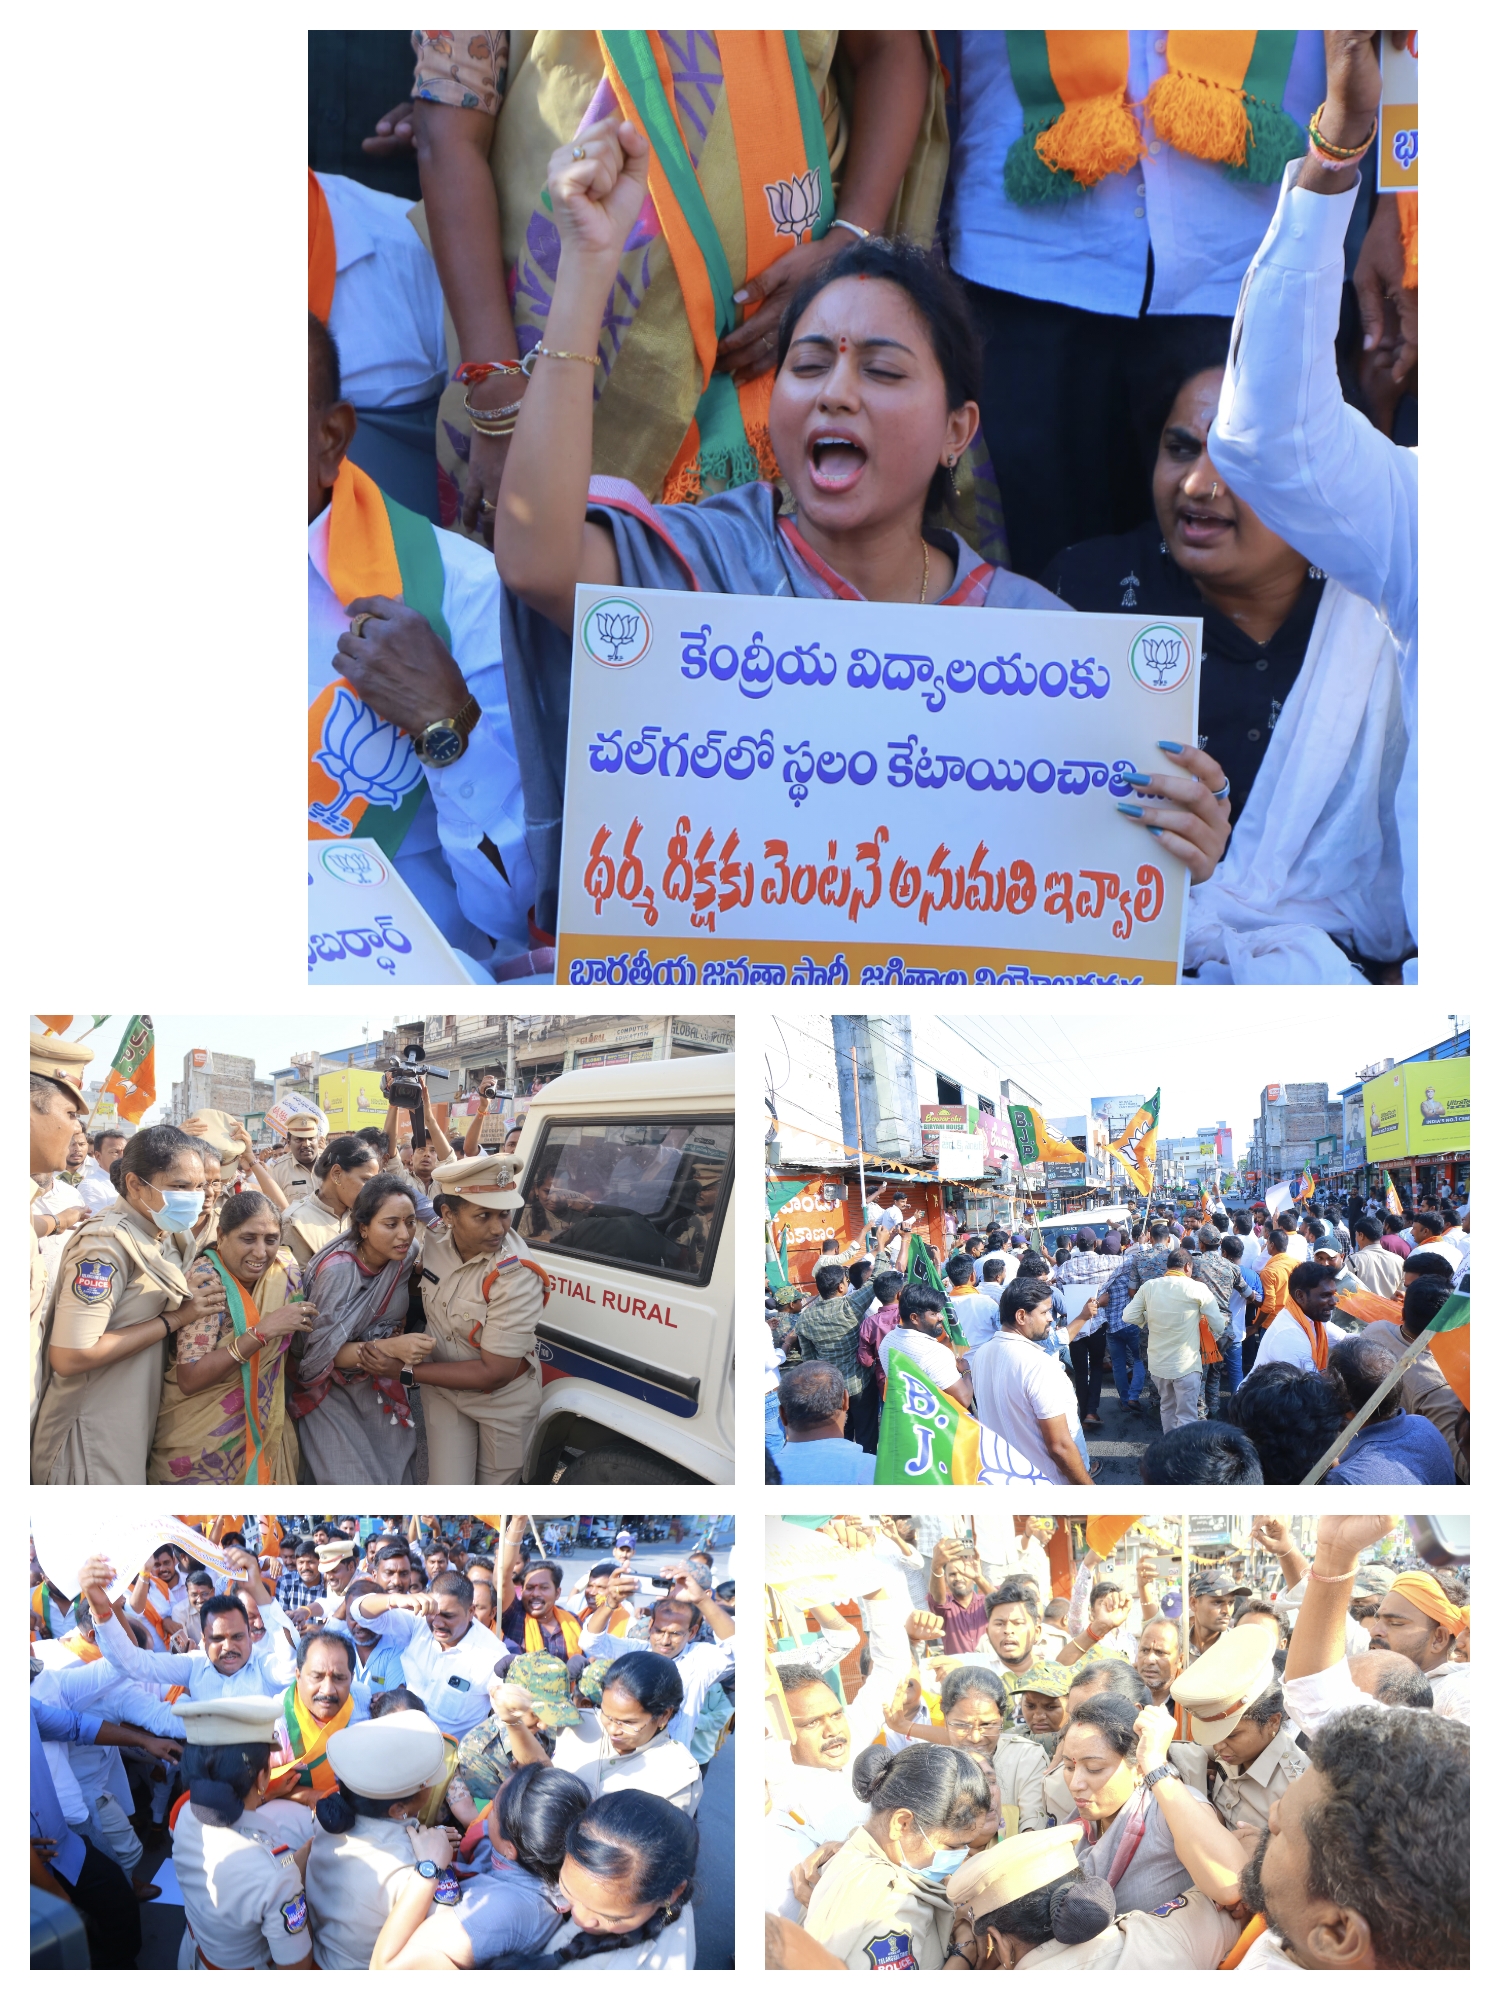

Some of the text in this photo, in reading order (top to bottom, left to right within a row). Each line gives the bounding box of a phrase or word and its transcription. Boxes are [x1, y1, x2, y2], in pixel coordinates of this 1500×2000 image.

[680, 623, 1111, 712] కేంద్రీయ విద్యాలయంకు
[783, 740, 878, 808] స్థలం
[662, 815, 755, 933] దీక్షకు
[761, 825, 890, 924] వెంటనే
[889, 839, 1037, 926] అనుమతి
[1043, 864, 1165, 940] ఇవ్వాలి
[616, 1024, 649, 1035] COMPUTER
[78, 1278, 109, 1288] POLICE
[602, 1289, 678, 1329] RURAL
[877, 1956, 913, 1970] POLICE
